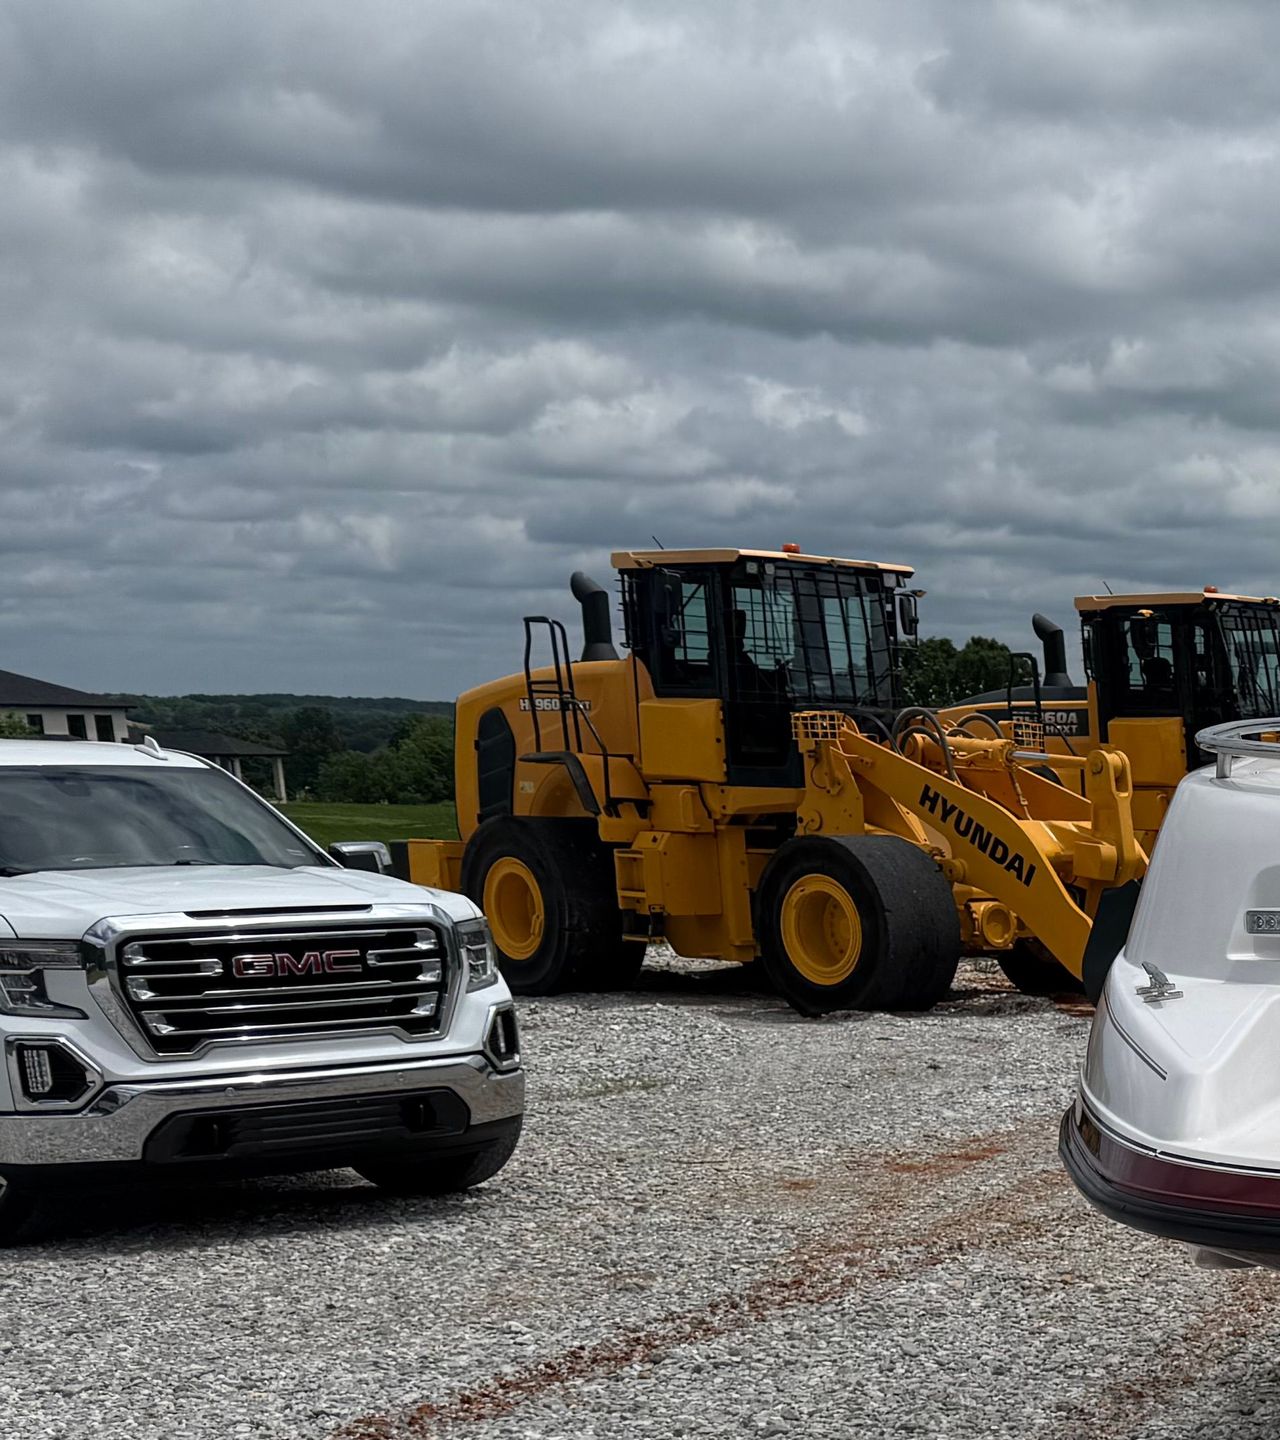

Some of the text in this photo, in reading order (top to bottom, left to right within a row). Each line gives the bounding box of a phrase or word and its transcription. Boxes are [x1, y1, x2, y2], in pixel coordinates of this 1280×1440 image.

[519, 698, 561, 711] H960
[918, 783, 1037, 888] HYUNDAI
[232, 949, 363, 978] GMC
